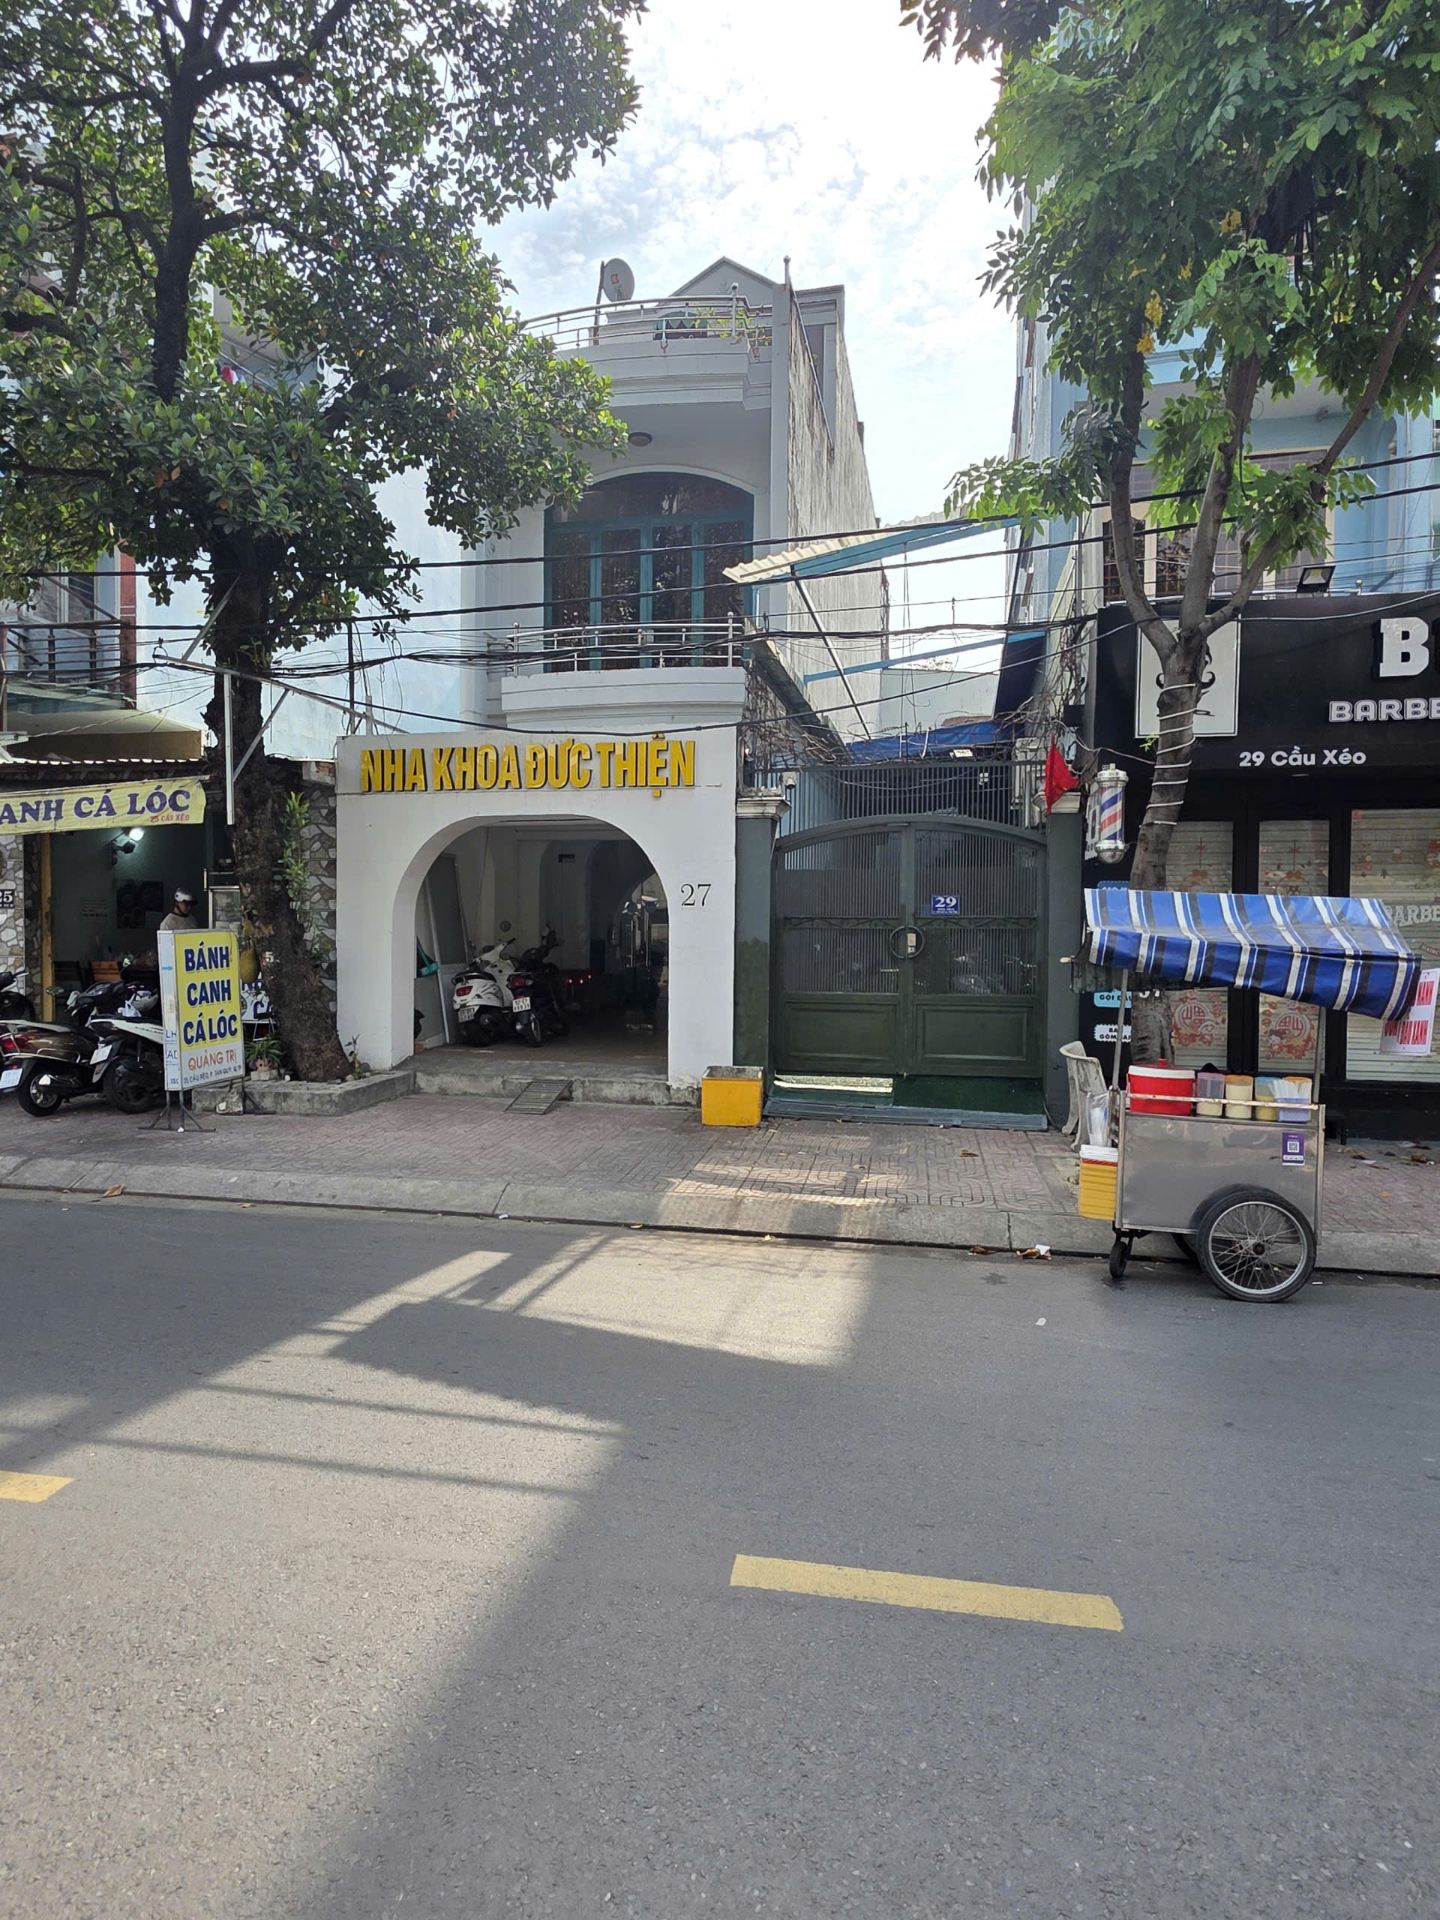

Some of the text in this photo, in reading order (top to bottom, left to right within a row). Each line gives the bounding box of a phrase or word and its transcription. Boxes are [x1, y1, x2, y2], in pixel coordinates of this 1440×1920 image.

[1379, 617, 1430, 677] B
[360, 748, 426, 793] NHA
[432, 744, 521, 791] KHOA
[595, 731, 696, 798] THIỆN
[1239, 746, 1367, 767] 29 Cầu Xéo
[74, 788, 117, 818] CÁ
[127, 784, 191, 815] LÓC
[681, 883, 712, 907] 27
[935, 896, 957, 908] 29
[184, 941, 230, 972] BÁNH
[187, 979, 232, 1006] CANH
[183, 1012, 206, 1045] CÁ
[208, 1009, 238, 1041] LÓC
[187, 1049, 224, 1071] QUẢNG
